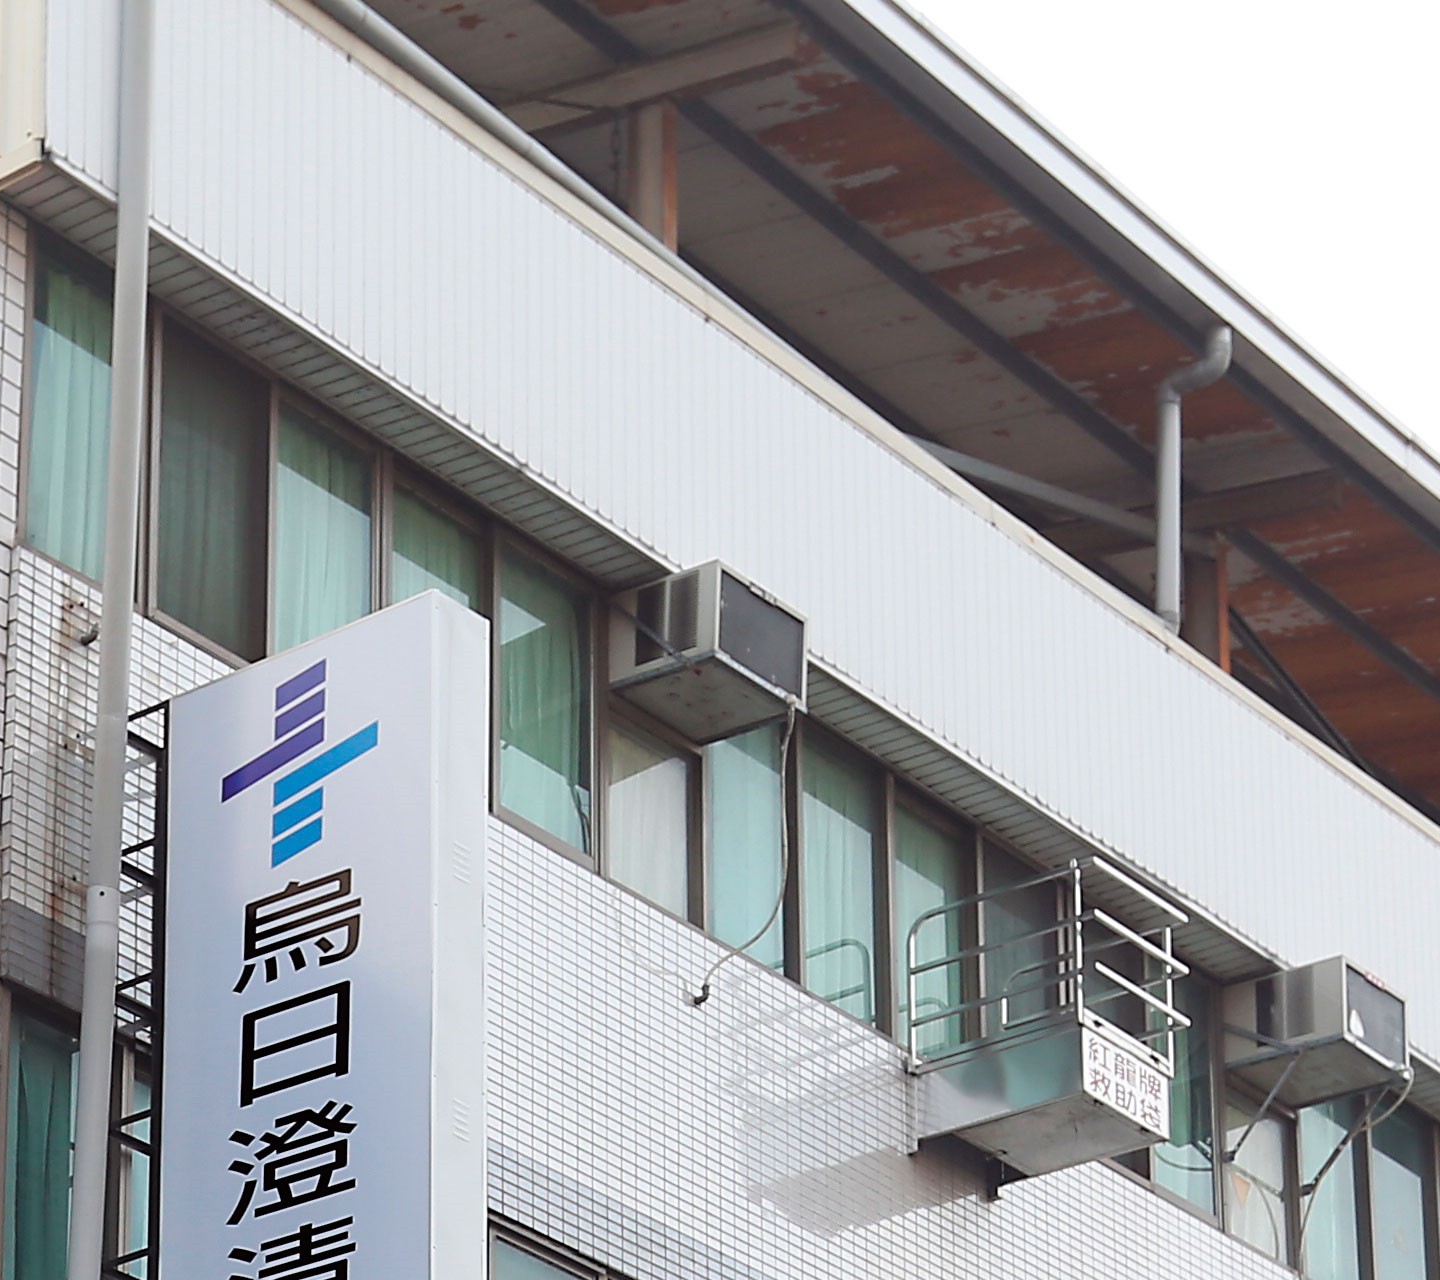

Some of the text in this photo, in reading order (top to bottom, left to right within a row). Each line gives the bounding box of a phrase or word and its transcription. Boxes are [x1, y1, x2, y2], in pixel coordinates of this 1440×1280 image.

[1088, 1037, 1161, 1101] 紅龍牌
[1089, 1067, 1163, 1132] 救助袋
